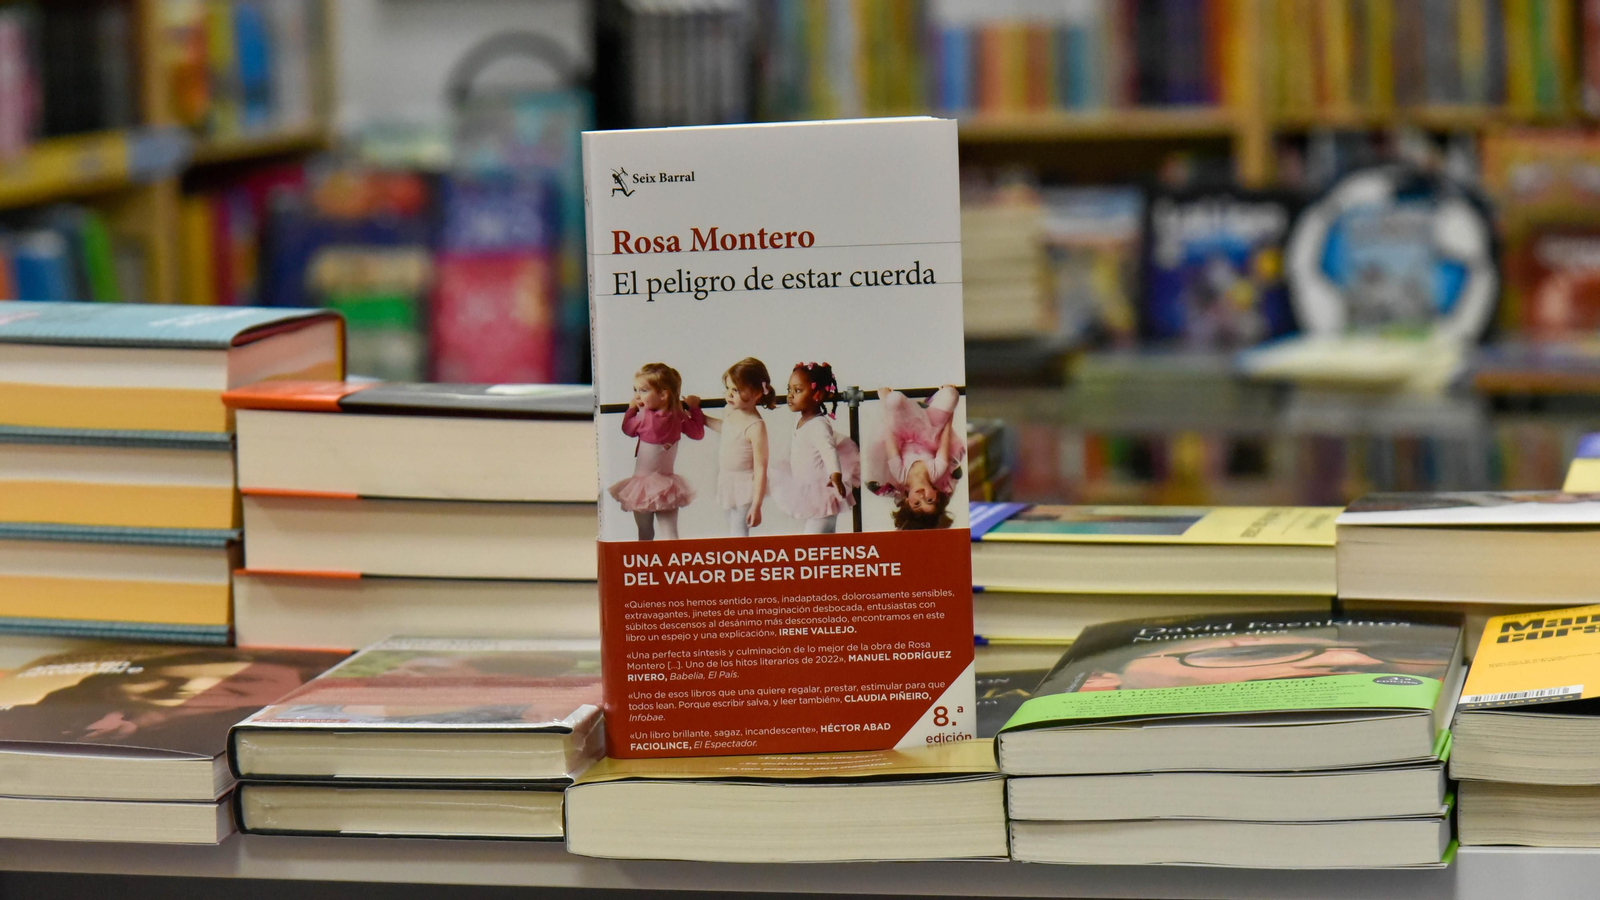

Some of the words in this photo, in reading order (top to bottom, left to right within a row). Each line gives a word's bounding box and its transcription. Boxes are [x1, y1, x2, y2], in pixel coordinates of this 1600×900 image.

[632, 173, 656, 183] Seix
[659, 171, 695, 182] Barral
[611, 230, 682, 254] Rosa
[689, 227, 815, 251] Montero
[612, 270, 639, 295] El
[645, 269, 735, 301] peligro
[743, 266, 773, 290] de
[781, 269, 842, 289] estar
[849, 261, 936, 286] cuerda
[623, 554, 662, 567] UNA
[667, 549, 789, 565] APASIONADA
[794, 545, 879, 560] DEFENSA
[624, 572, 659, 585] DEL
[663, 569, 725, 584] VALOR
[731, 568, 755, 581] DE
[760, 567, 794, 580] SER
[800, 562, 901, 578] DIFERENTE
[624, 600, 666, 608] «Quienes
[719, 597, 752, 605] sentido
[781, 594, 840, 602] inadaptados,
[841, 591, 909, 600] dolorosamente
[911, 589, 955, 597] sensibles,
[624, 611, 691, 619] extravagantes,
[692, 609, 721, 618] jinetes
[723, 608, 735, 616] de
[756, 606, 810, 615] imaginación
[812, 603, 865, 612] desbocada,
[866, 602, 917, 610] entusiastas
[718, 619, 762, 627] desánimo
[784, 615, 850, 624] desconsolado,
[1139, 622, 1233, 636] David
[1248, 619, 1411, 629] Foenkinos
[719, 629, 777, 638] explicación»,
[779, 627, 808, 635] IRENE
[810, 625, 857, 634] VALLEJO.
[626, 651, 649, 659] «Una
[652, 650, 690, 658] perfecta
[728, 649, 734, 657] y
[736, 646, 791, 655] culminación
[793, 645, 805, 653] de
[846, 643, 858, 651] de
[870, 642, 891, 650] obra
[894, 641, 905, 649] de
[908, 641, 930, 650] Rosa
[667, 660, 684, 670] [...].
[685, 660, 704, 668] Uno
[706, 660, 718, 668] de
[735, 658, 757, 666] hitos
[759, 657, 799, 665] literarios
[815, 654, 846, 663] 2022»,
[848, 653, 890, 661] MANUEL
[892, 650, 951, 660] RODRÍGUEZ
[627, 673, 668, 681] RIVERO,
[669, 672, 705, 680] Babelia,
[718, 670, 740, 678] País.
[628, 691, 652, 699] «Uno
[718, 689, 735, 697] que
[756, 687, 785, 695] quiere
[788, 685, 822, 694] regalar,
[824, 684, 859, 693] prestar,
[860, 682, 904, 691] estimular
[927, 681, 946, 690] que
[628, 702, 653, 710] todos
[678, 700, 710, 708] Porque
[712, 699, 744, 707] escribir
[746, 698, 771, 706] salva,
[798, 696, 843, 704] también»,
[844, 693, 887, 702] CLAUDIA
[889, 691, 932, 700] PIÑEIRO,
[628, 713, 666, 721] Infobae.
[714, 729, 743, 737] sagaz,
[745, 726, 818, 734] incandescente»,
[820, 723, 860, 732] HÉCTOR
[862, 722, 891, 730] ABAD
[926, 731, 972, 744] edición
[630, 741, 692, 750] FACIOLINCE,
[693, 740, 702, 748] El
[704, 739, 758, 748] Espectador.
